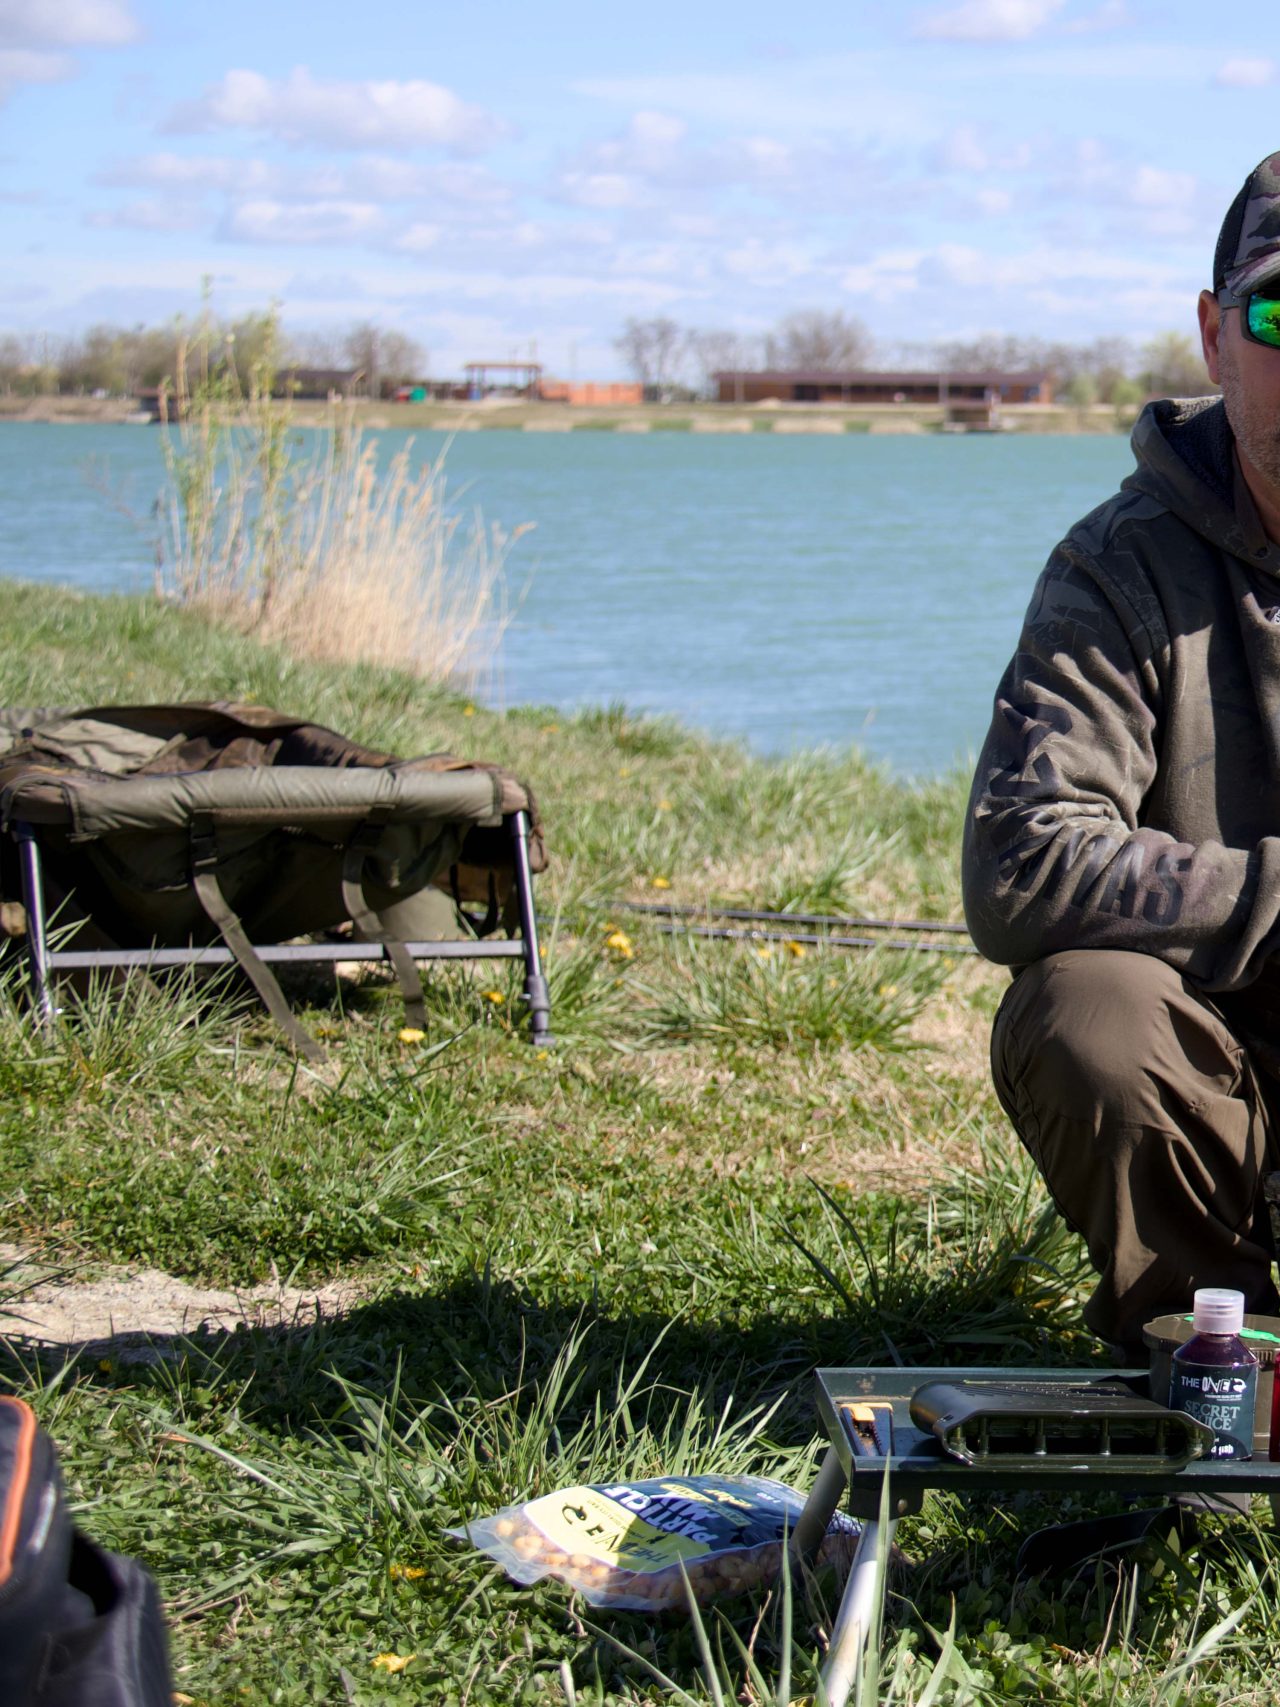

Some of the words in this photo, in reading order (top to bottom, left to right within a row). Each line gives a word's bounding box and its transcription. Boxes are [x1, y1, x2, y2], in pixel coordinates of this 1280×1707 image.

[1180, 1375, 1200, 1388] THE
[1201, 1376, 1231, 1393] ONE
[1184, 1400, 1240, 1419] SECRET
[602, 1485, 719, 1545] PARTICLE
